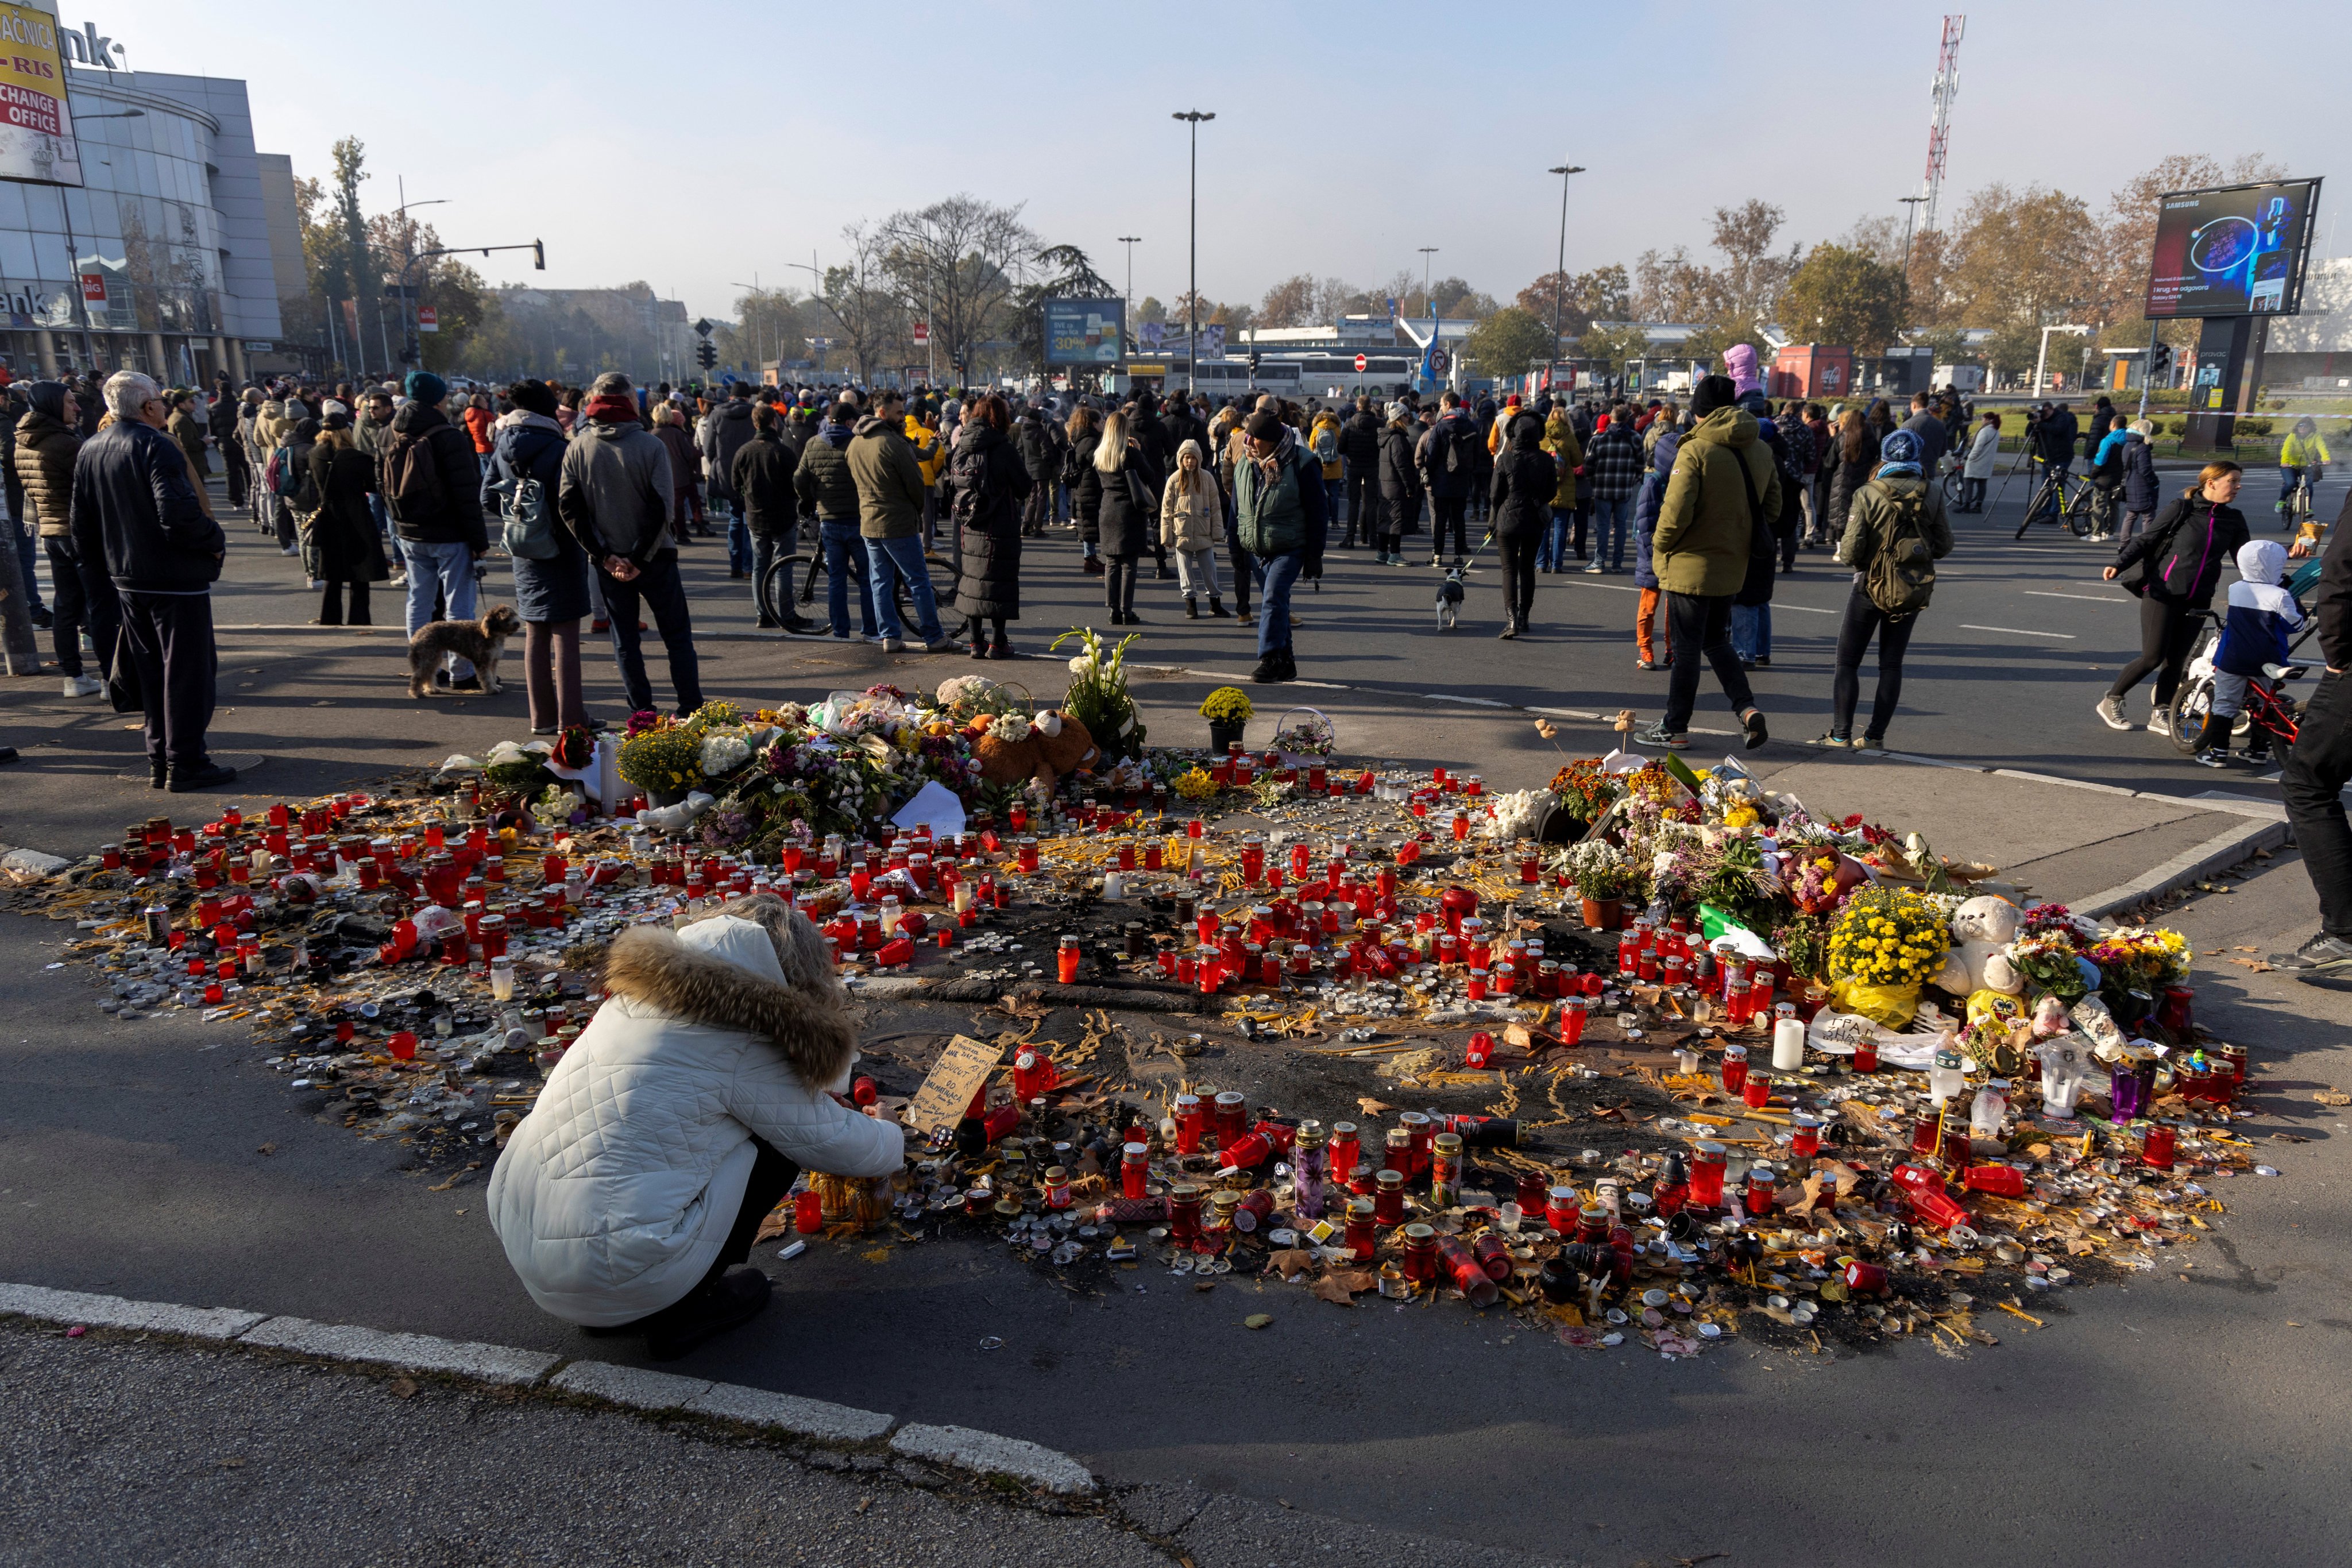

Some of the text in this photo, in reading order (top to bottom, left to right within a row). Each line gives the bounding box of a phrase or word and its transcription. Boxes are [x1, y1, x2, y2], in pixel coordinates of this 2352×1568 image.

[0, 9, 56, 52] AČNICA
[11, 56, 54, 79] RIS
[9, 106, 57, 133] OFFICE
[2166, 200, 2200, 209] SAMSUNG
[2179, 285, 2210, 293] odgovora
